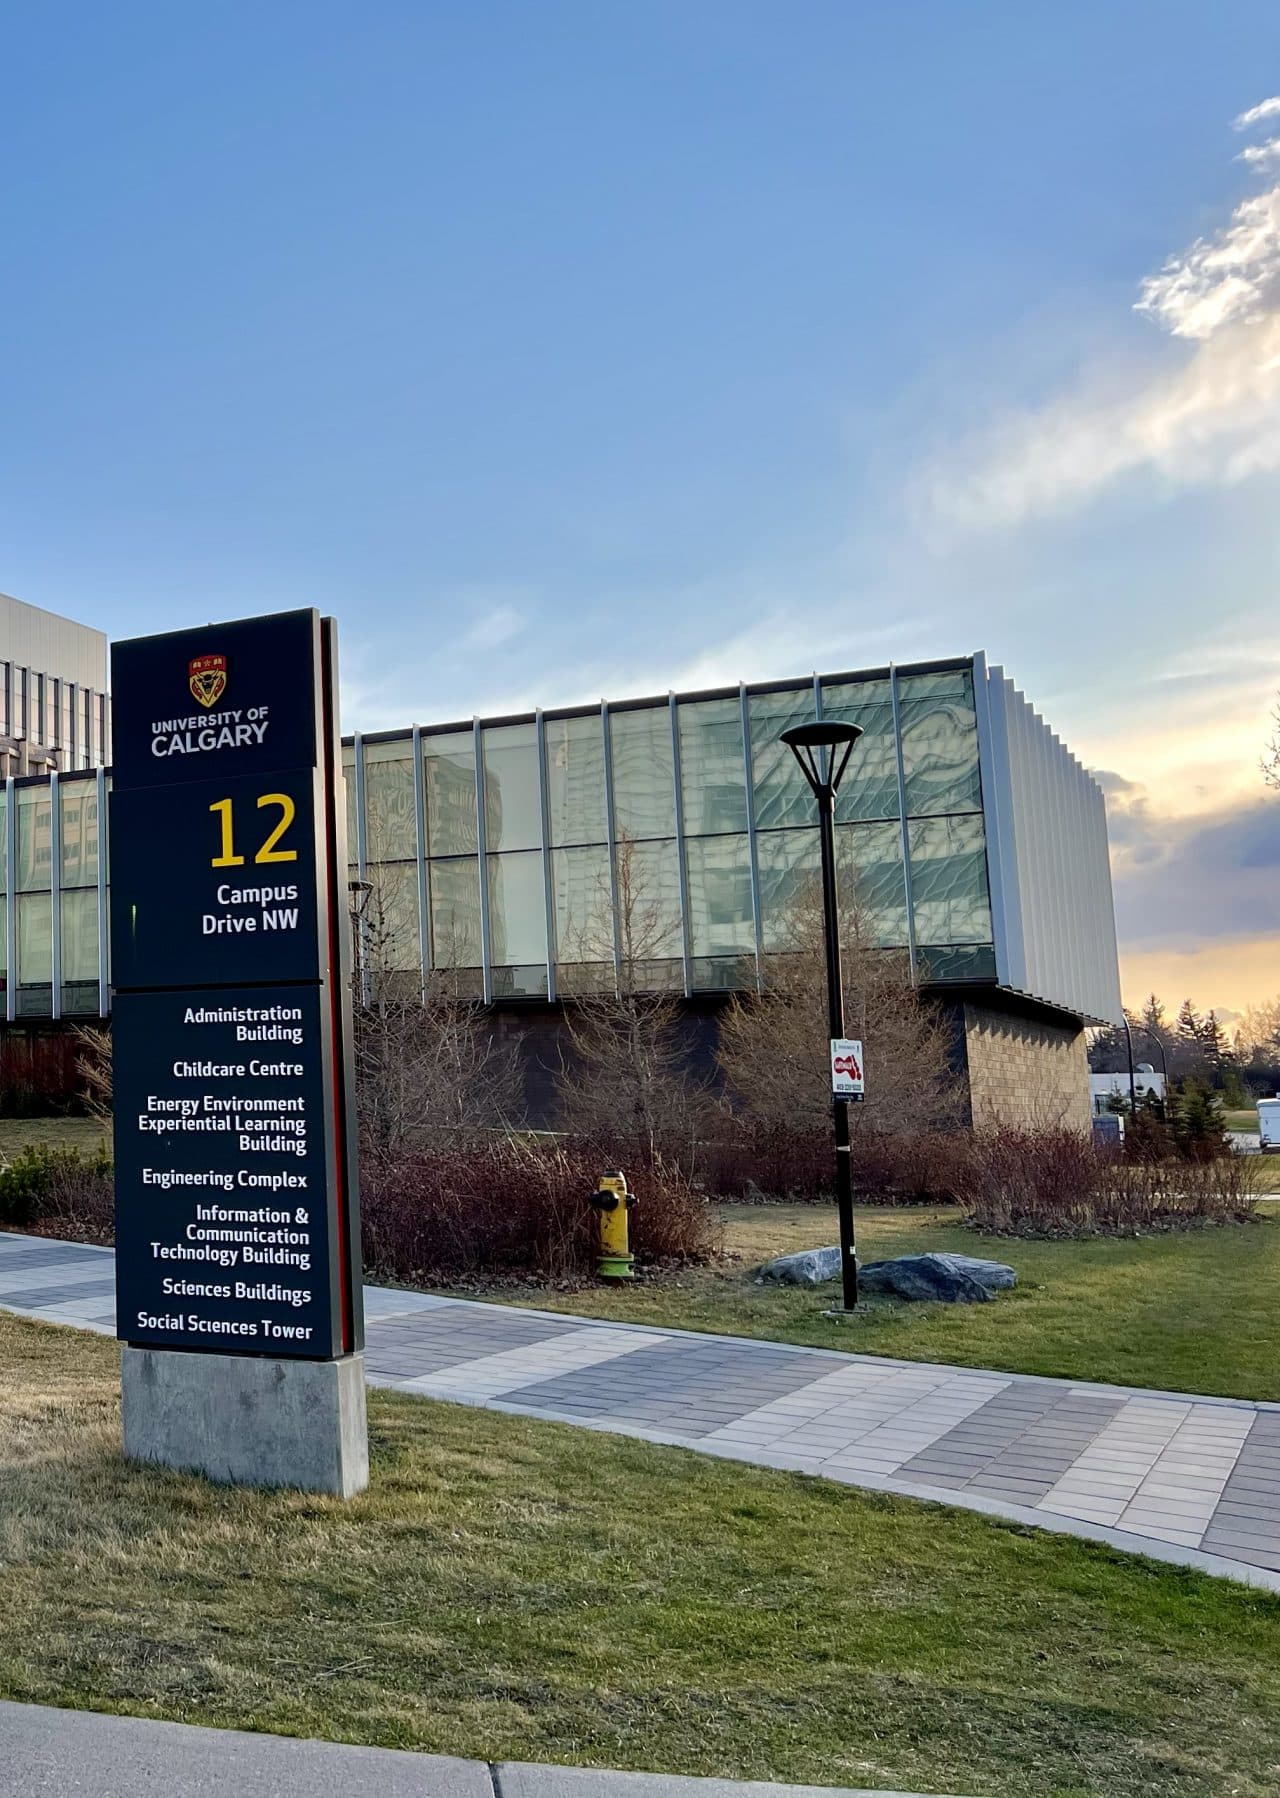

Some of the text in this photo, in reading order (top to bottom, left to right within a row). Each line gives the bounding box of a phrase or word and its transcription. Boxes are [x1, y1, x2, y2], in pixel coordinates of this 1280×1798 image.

[151, 706, 269, 734] UNIVERSITY OF
[151, 721, 269, 757] CALGARY
[209, 793, 298, 868] 12
[217, 884, 298, 908] Campus
[202, 908, 299, 935] Drive NW
[183, 1005, 302, 1024] Administration
[236, 1024, 304, 1045] Building
[173, 1059, 304, 1078] Childcare Centre
[147, 1095, 305, 1116] Energy Environment
[138, 1114, 307, 1137] Experiential Learning
[239, 1134, 308, 1157] Building
[142, 1168, 308, 1192] Engineering Complex
[196, 1204, 309, 1225] Information &
[186, 1223, 310, 1246] Communication
[150, 1241, 312, 1271] Technology Building
[162, 1277, 312, 1307] Sciences Buildings
[137, 1311, 313, 1340] Social Sciences Tower
